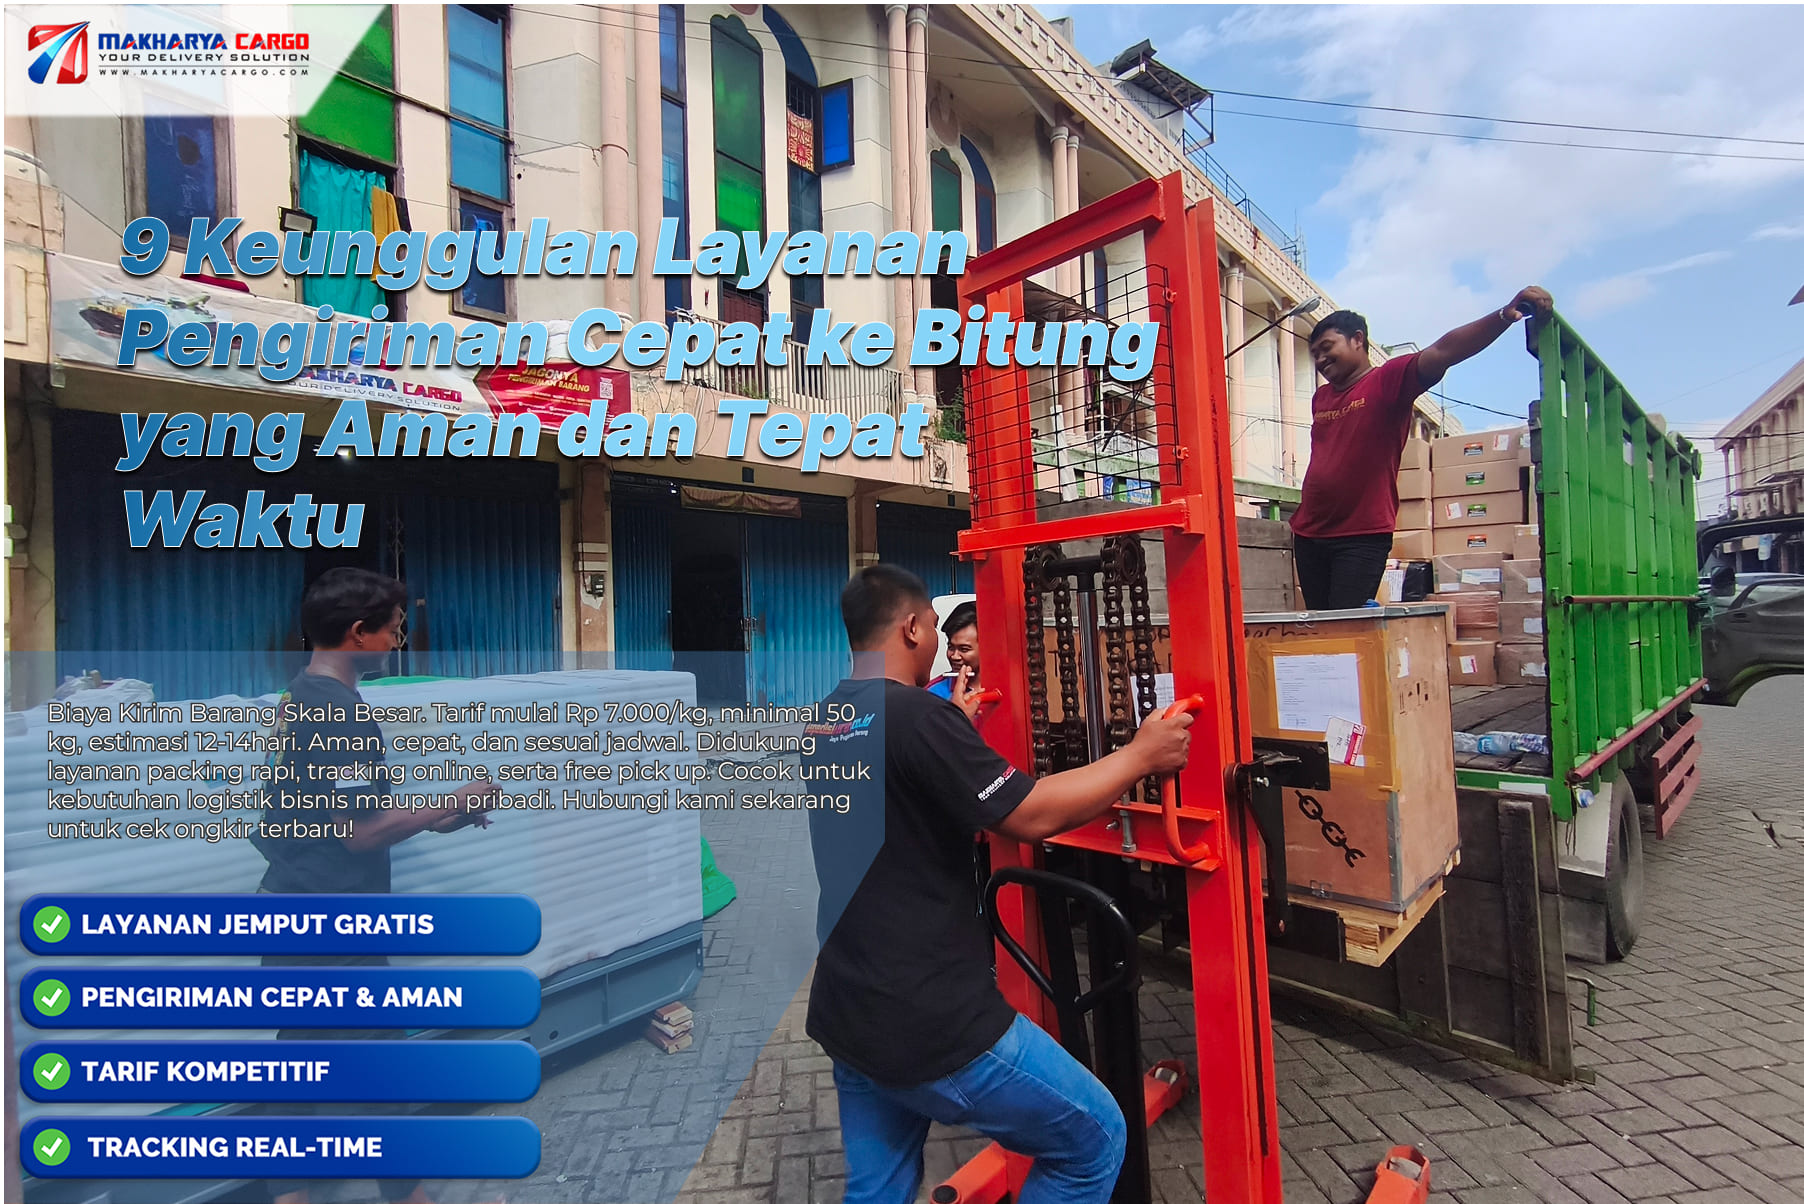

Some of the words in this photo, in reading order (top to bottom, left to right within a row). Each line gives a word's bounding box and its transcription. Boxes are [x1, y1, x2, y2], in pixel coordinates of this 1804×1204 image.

[298, 366, 397, 392] AKHARYA
[402, 382, 463, 404] CARGO
[522, 367, 579, 384] JAGONYA
[558, 380, 590, 392] BARANG
[286, 380, 319, 389] OUR
[323, 384, 394, 399] DELIVERY
[396, 395, 460, 411] SOLUTION
